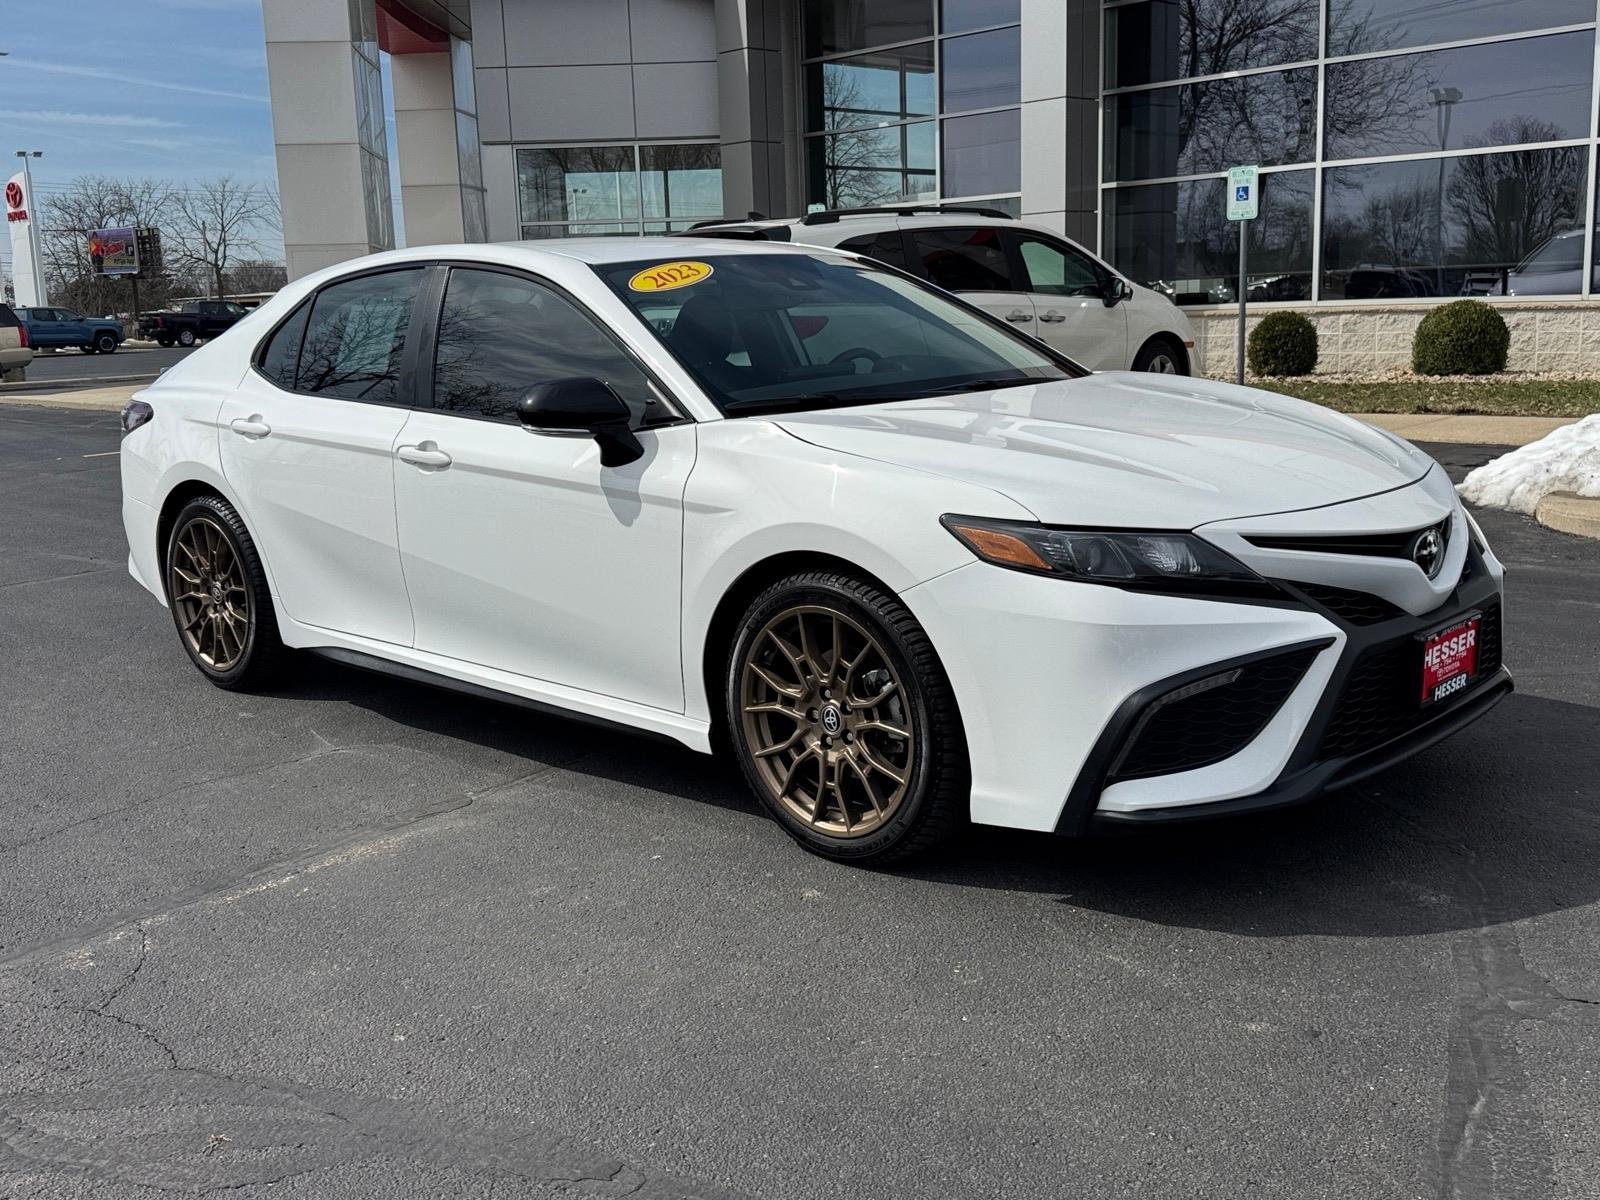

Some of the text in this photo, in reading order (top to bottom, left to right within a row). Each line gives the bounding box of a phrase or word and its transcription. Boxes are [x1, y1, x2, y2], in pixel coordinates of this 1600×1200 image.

[643, 264, 701, 288] 2023
[1424, 629, 1476, 669] HESSER
[1434, 673, 1467, 701] HESSER
